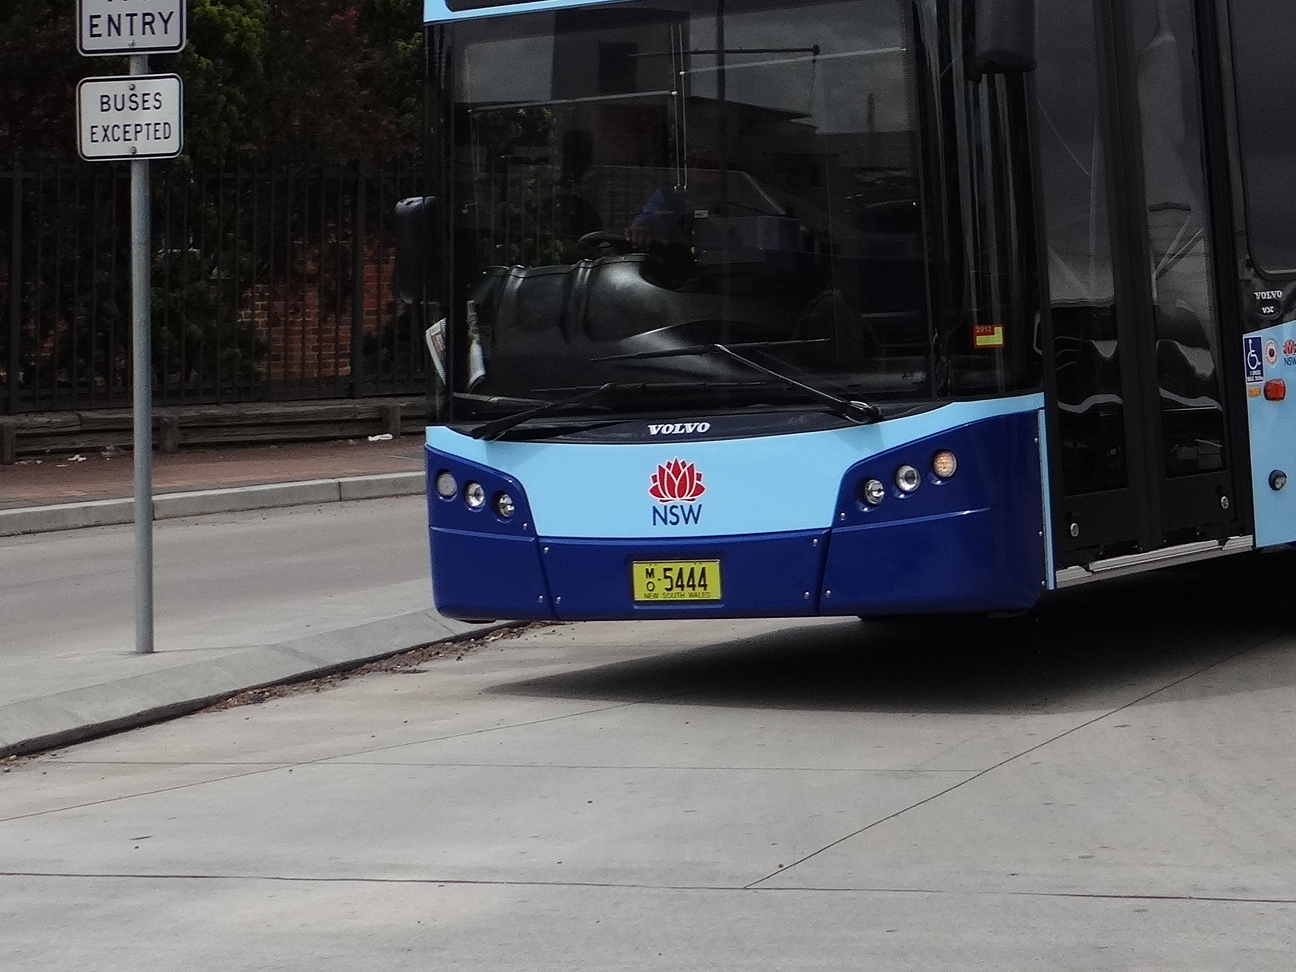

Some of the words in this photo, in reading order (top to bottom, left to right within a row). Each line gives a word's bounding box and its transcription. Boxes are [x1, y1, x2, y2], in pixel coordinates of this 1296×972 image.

[89, 11, 175, 38] ENTRY
[100, 92, 163, 112] BUSES
[90, 122, 172, 143] EXCEPTED
[1253, 290, 1283, 299] VOLVO
[648, 422, 711, 435] VOLVO
[652, 504, 703, 526] NSW
[663, 567, 708, 592] 5444
[689, 591, 711, 599] WALES
